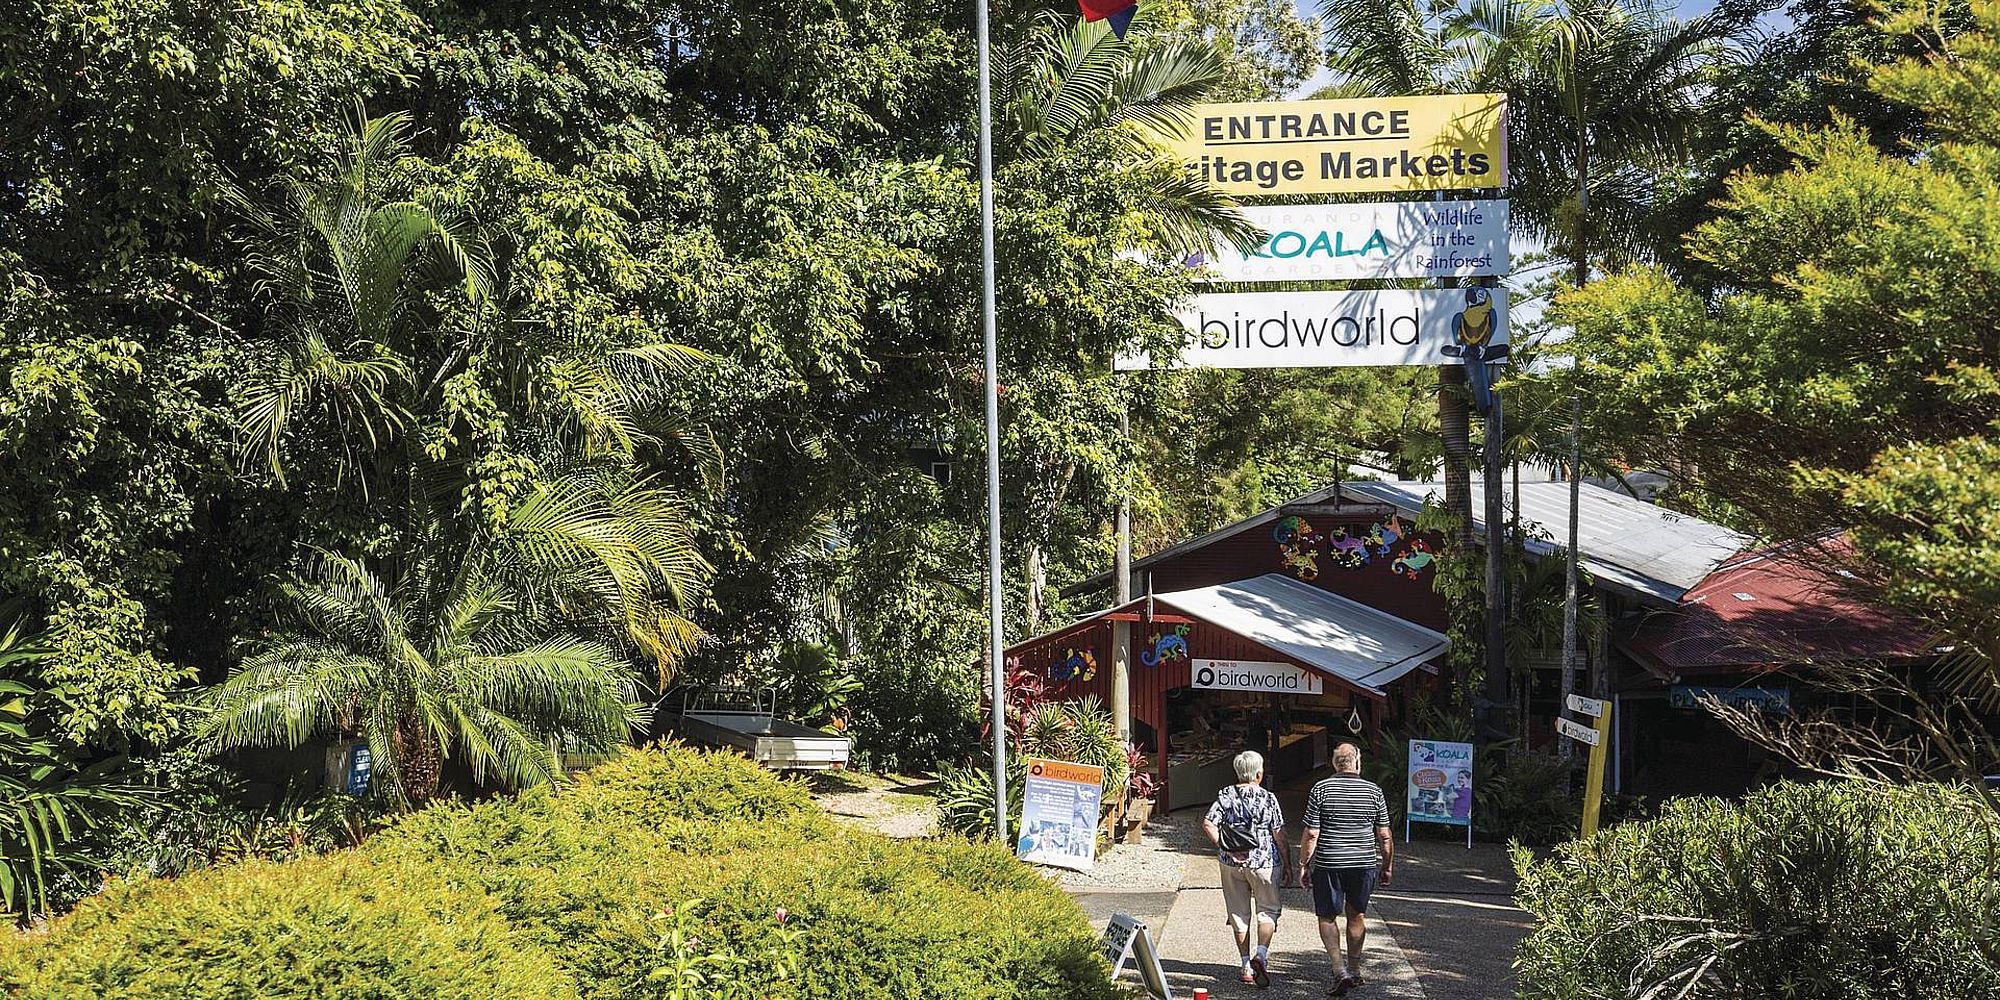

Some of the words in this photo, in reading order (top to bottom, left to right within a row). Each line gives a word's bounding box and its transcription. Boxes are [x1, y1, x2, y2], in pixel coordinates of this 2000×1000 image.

[1204, 110, 1410, 140] ENTRANCE
[1184, 154, 1304, 188] itage
[1320, 149, 1490, 179] Markets
[1260, 212, 1384, 226] URANDA
[1424, 207, 1482, 226] Wildlife
[1431, 233, 1445, 247] in
[1449, 229, 1475, 246] the
[1416, 246, 1492, 270] Rainforest
[1200, 308, 1420, 349] birdworld
[1218, 670, 1298, 689] birdworld
[1436, 748, 1470, 760] KOALA
[1045, 765, 1101, 784] birdworld
